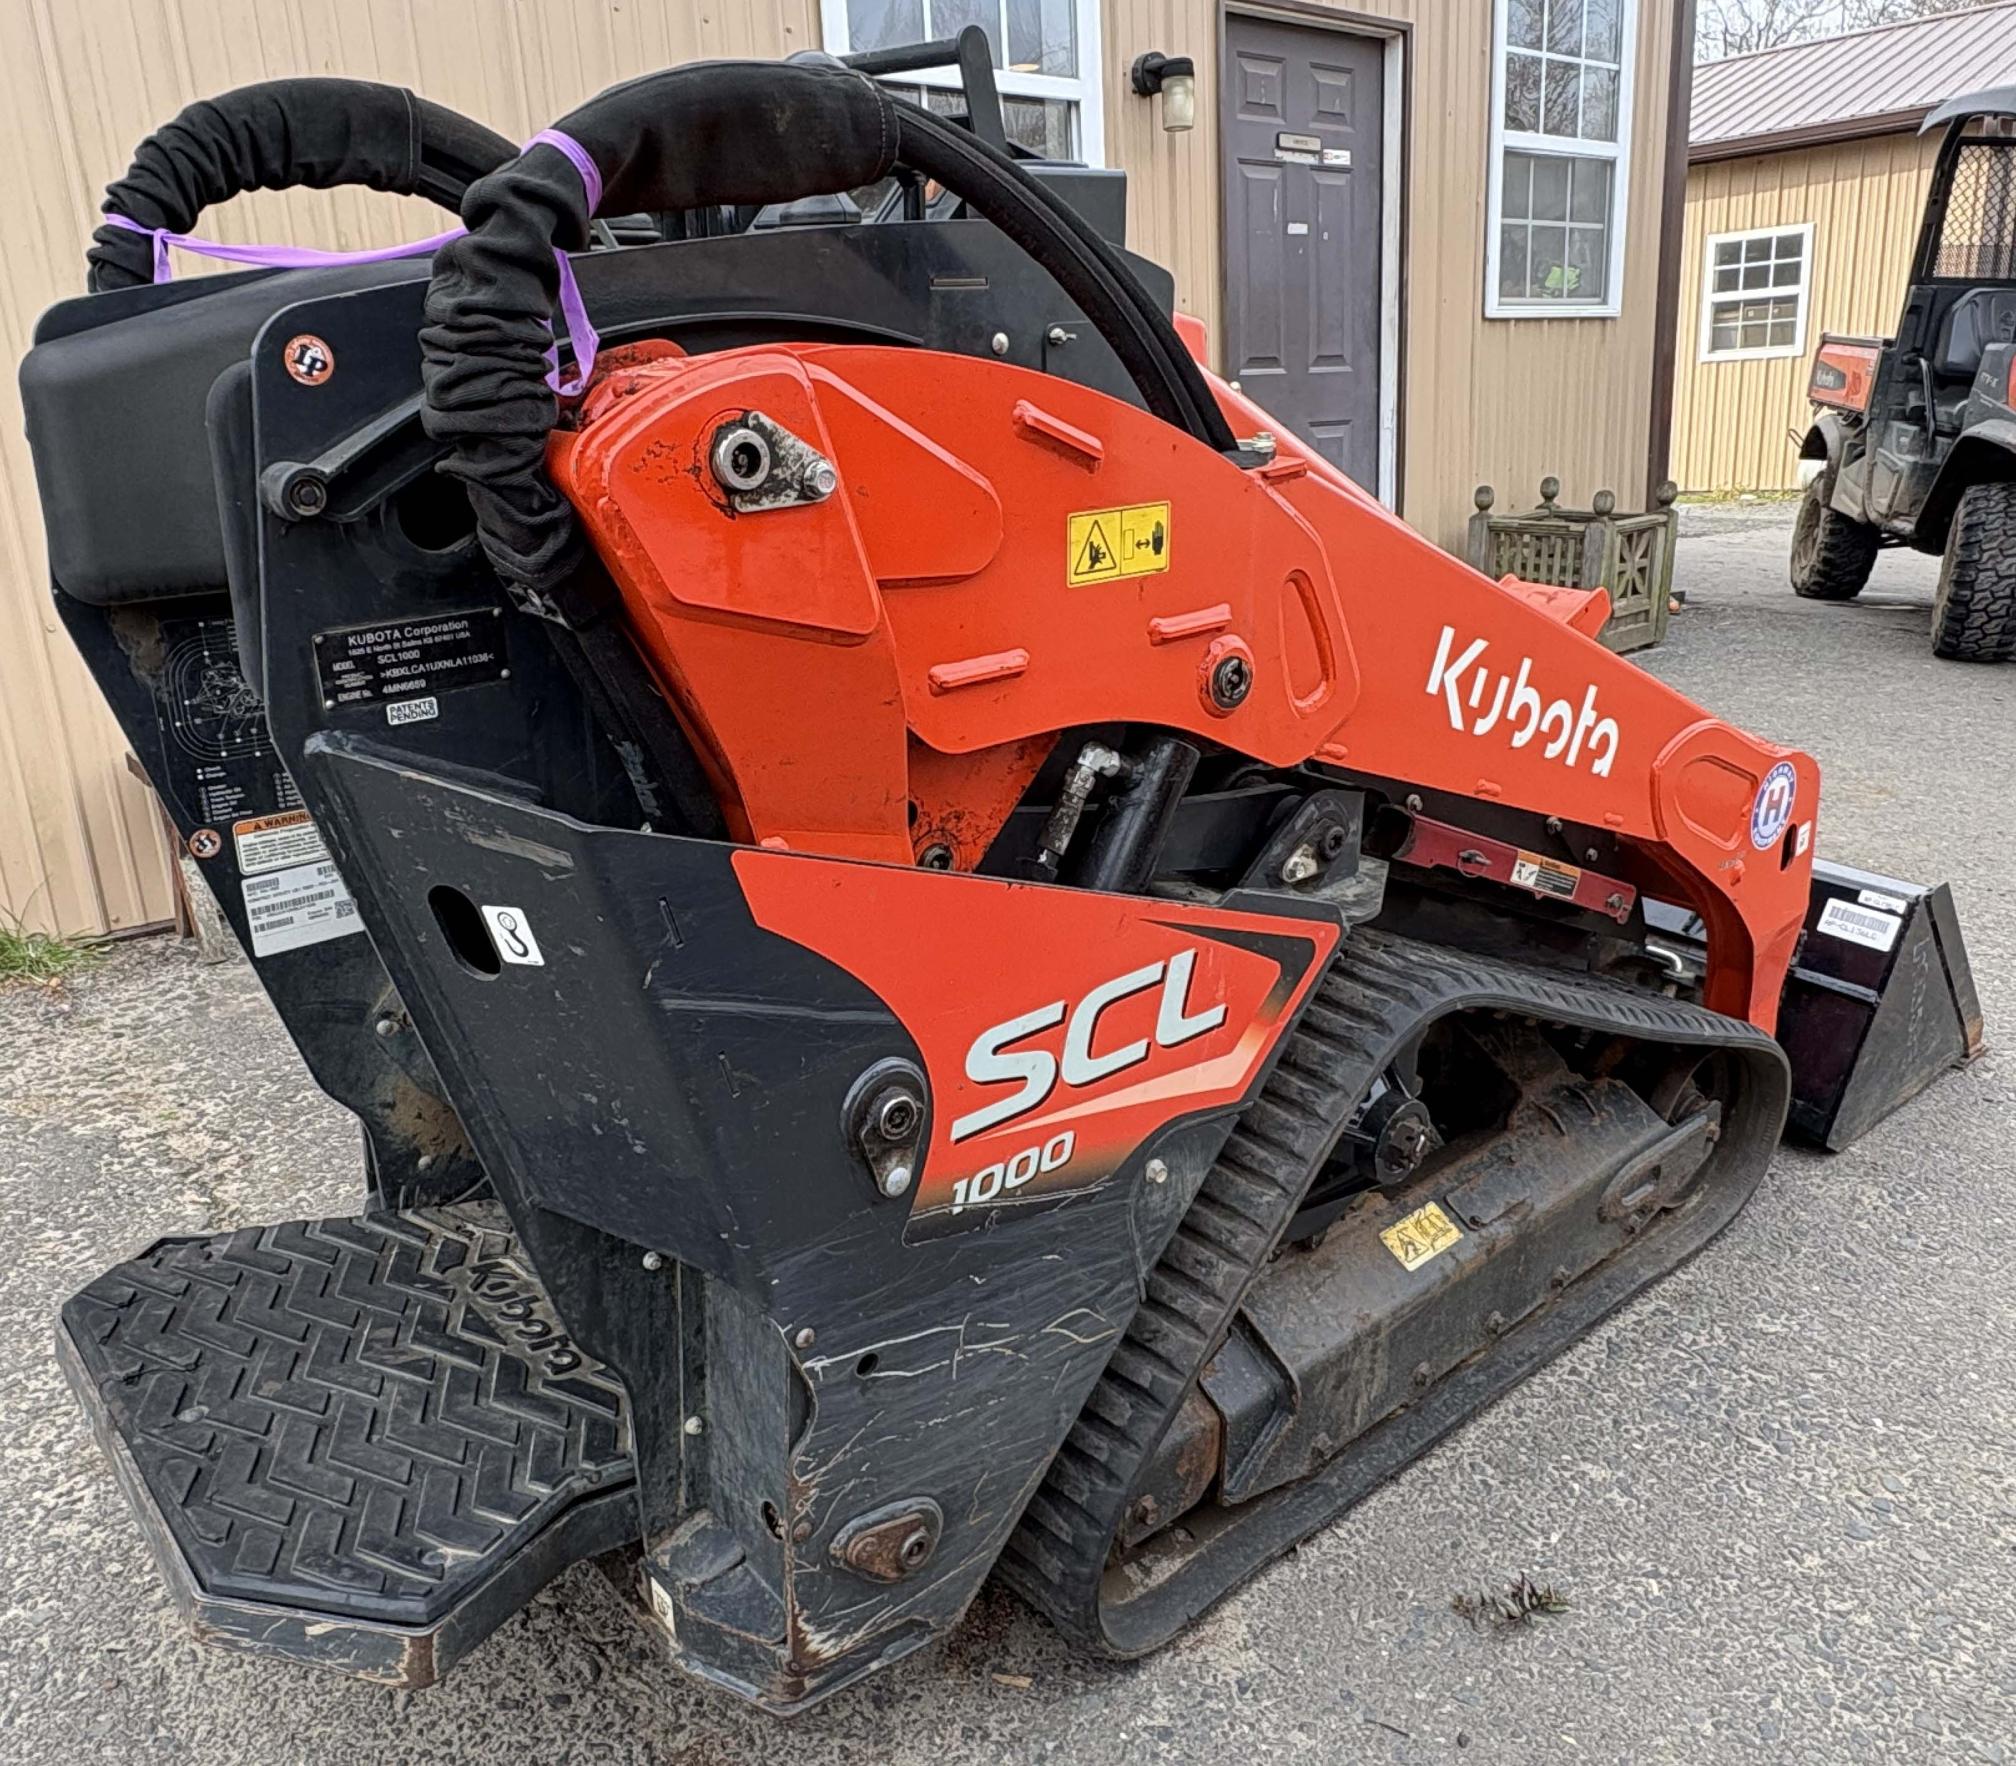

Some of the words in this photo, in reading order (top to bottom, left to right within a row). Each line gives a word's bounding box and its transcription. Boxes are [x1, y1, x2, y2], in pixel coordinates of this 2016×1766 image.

[348, 627, 401, 647] KUBOTA
[404, 620, 468, 640] Corporation
[377, 650, 420, 665] SCL1000
[389, 699, 434, 714] PATENTS
[390, 709, 435, 723] PENDING
[1425, 625, 1619, 777] Kubota
[1762, 785, 1786, 827] H
[950, 948, 1227, 1145] SCL
[951, 1130, 1076, 1216] 1000
[469, 1260, 582, 1376] Kubota
